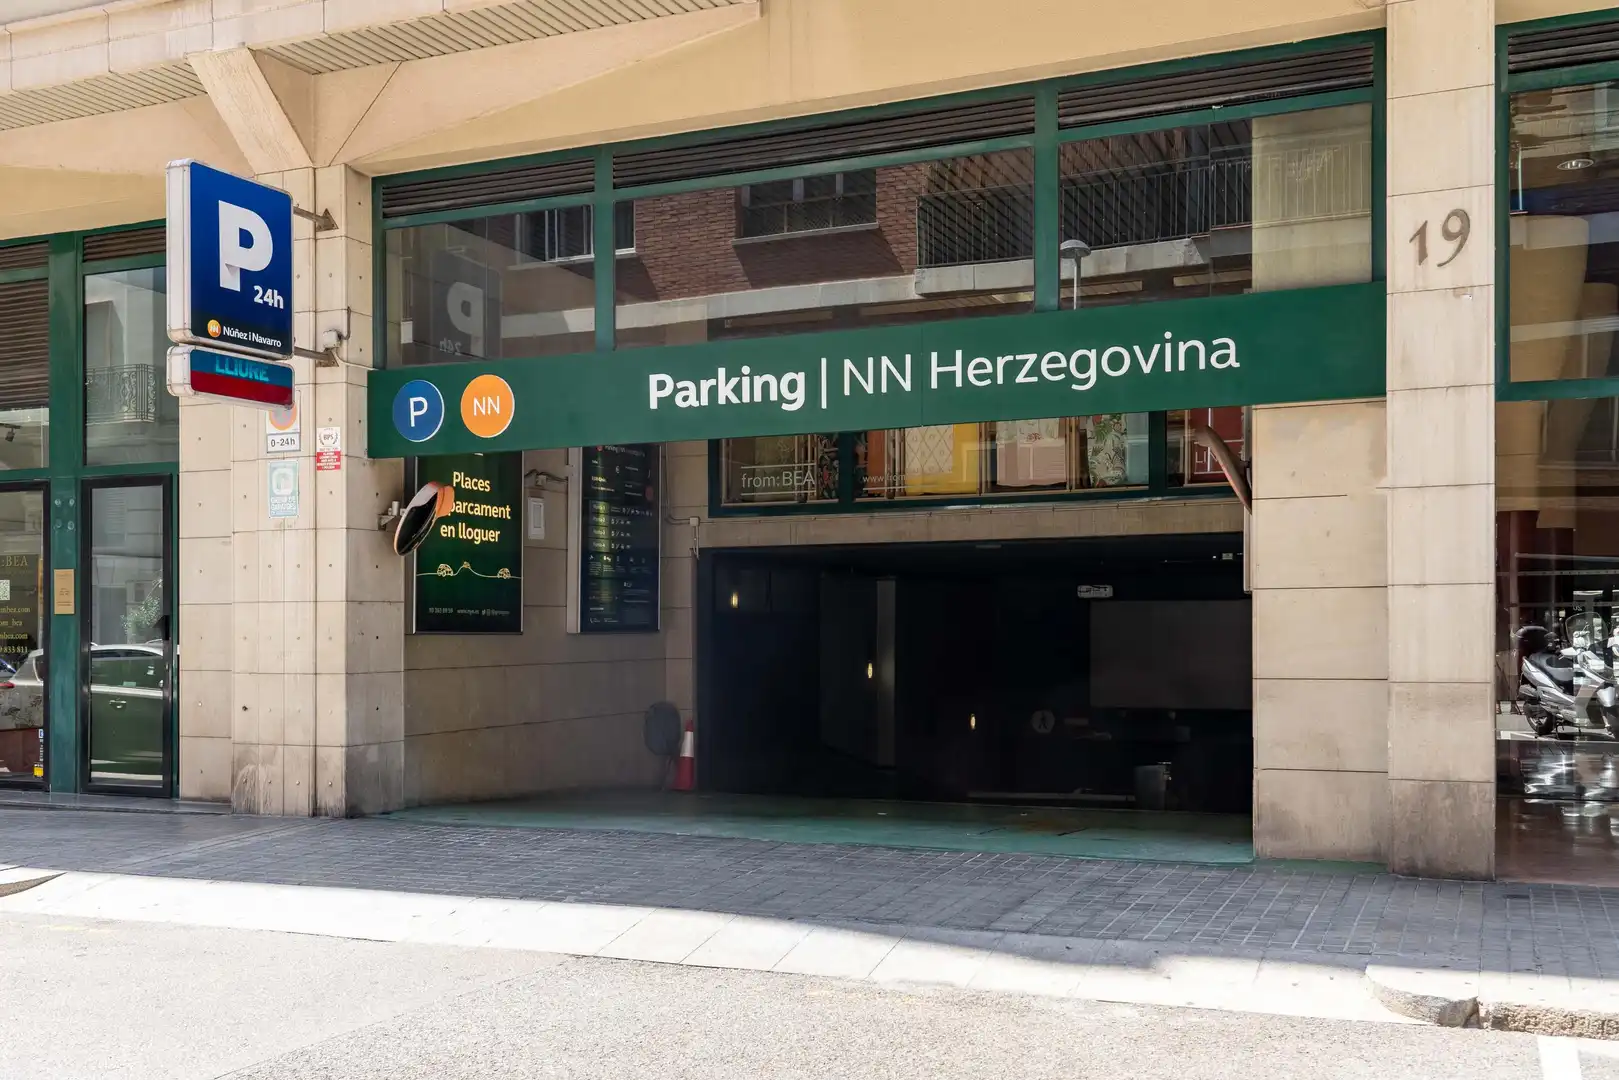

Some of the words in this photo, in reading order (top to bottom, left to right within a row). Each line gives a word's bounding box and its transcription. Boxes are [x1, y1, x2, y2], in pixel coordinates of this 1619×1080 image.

[218, 199, 274, 292] P
[1408, 208, 1471, 268] 19
[253, 285, 284, 309] 24h
[223, 326, 248, 340] Núñez
[248, 332, 252, 341] i
[252, 332, 282, 348] Navarro
[649, 366, 806, 411] Parking
[843, 354, 911, 396] NN
[930, 331, 1241, 391] Herzegovina
[409, 396, 428, 428] P
[473, 396, 501, 417] NN
[271, 438, 296, 447] 0-24h
[453, 471, 491, 492] Places
[440, 524, 455, 538] en
[458, 522, 500, 545] lloguer
